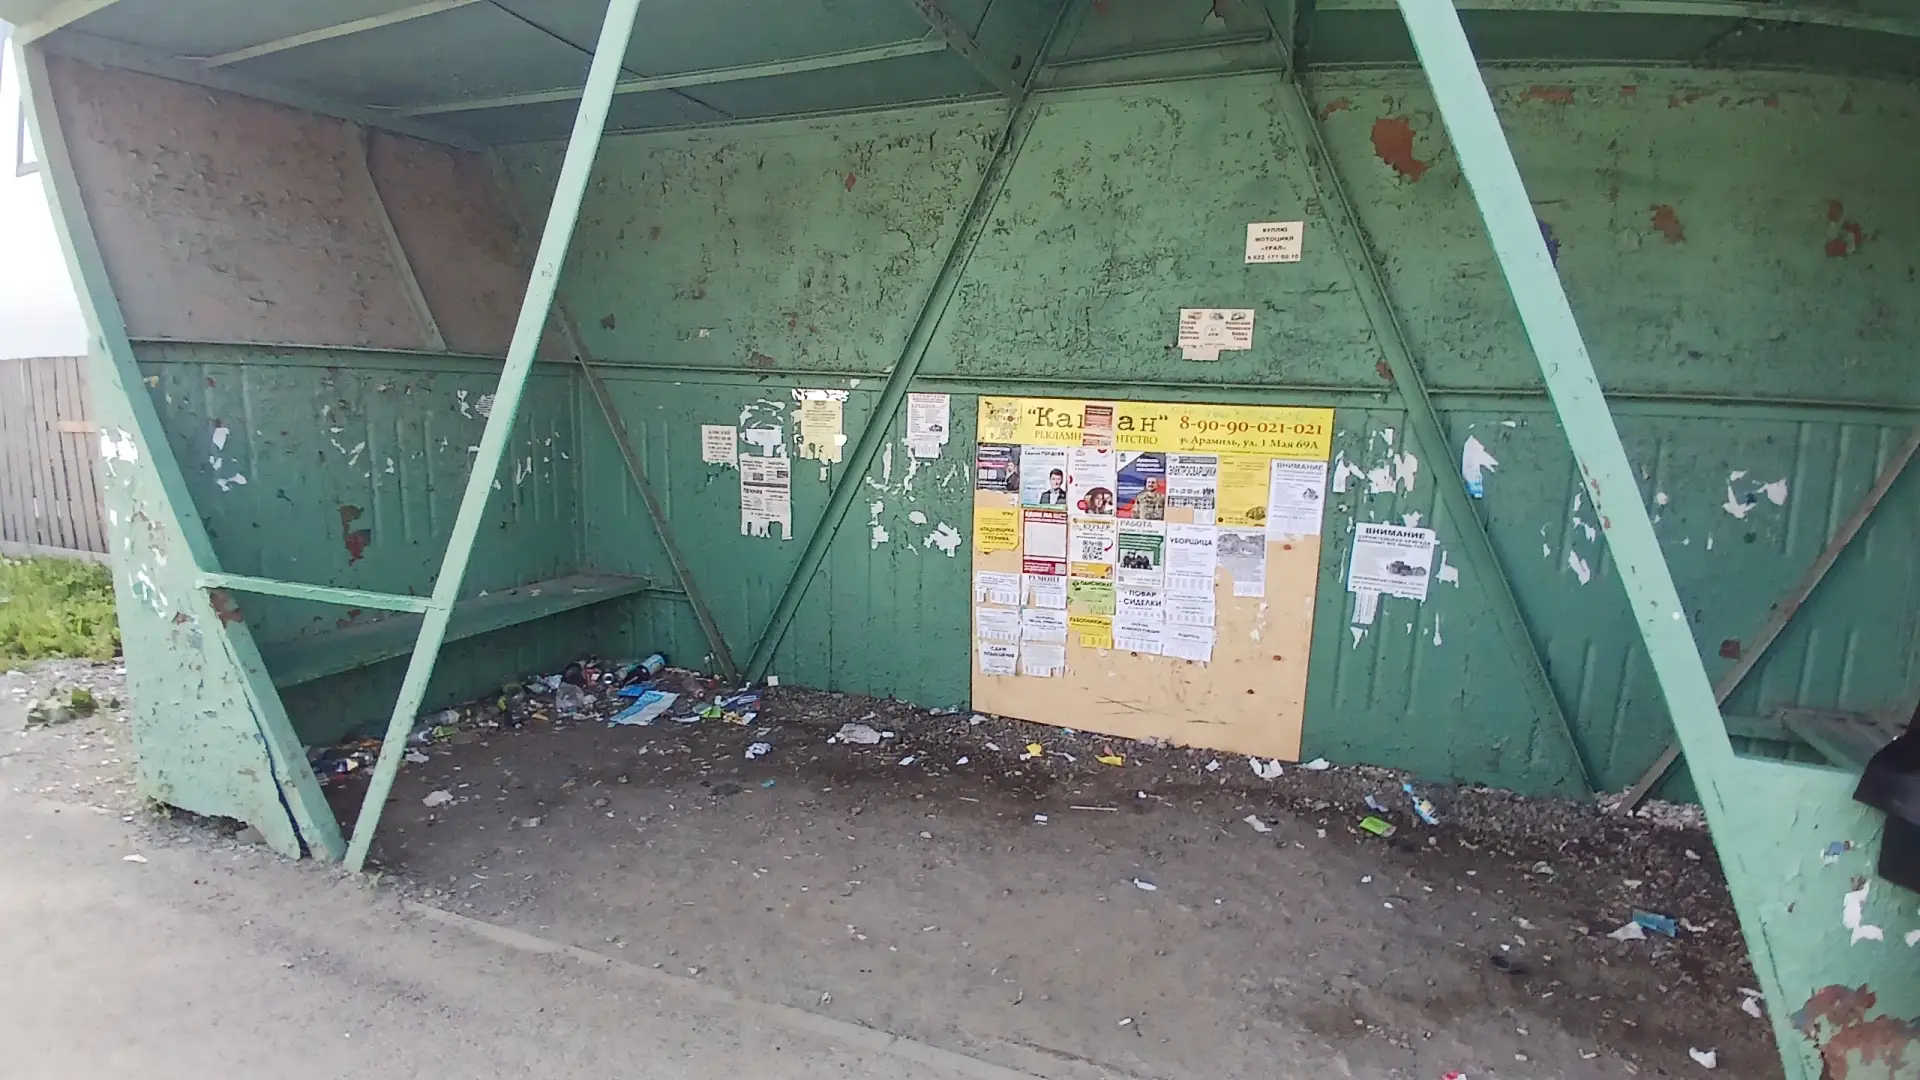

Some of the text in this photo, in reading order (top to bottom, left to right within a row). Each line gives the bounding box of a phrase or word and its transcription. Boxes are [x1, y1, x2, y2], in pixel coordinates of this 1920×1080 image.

[1179, 415, 1322, 436] 8-90-90-021-021
[1191, 436, 1240, 448] Арамиль,
[1242, 440, 1258, 448] ул.
[1261, 439, 1266, 447] 1
[1270, 439, 1293, 448] Мая
[1296, 440, 1318, 450] 69А
[1276, 462, 1324, 471] ВНИМАНИЕ
[1120, 520, 1153, 529] РАБОТА
[1366, 527, 1426, 539] ВНИМАНИЕ
[1169, 536, 1213, 547] УБОРЩИЦА
[1123, 598, 1162, 607] СИДЕЛКИ
